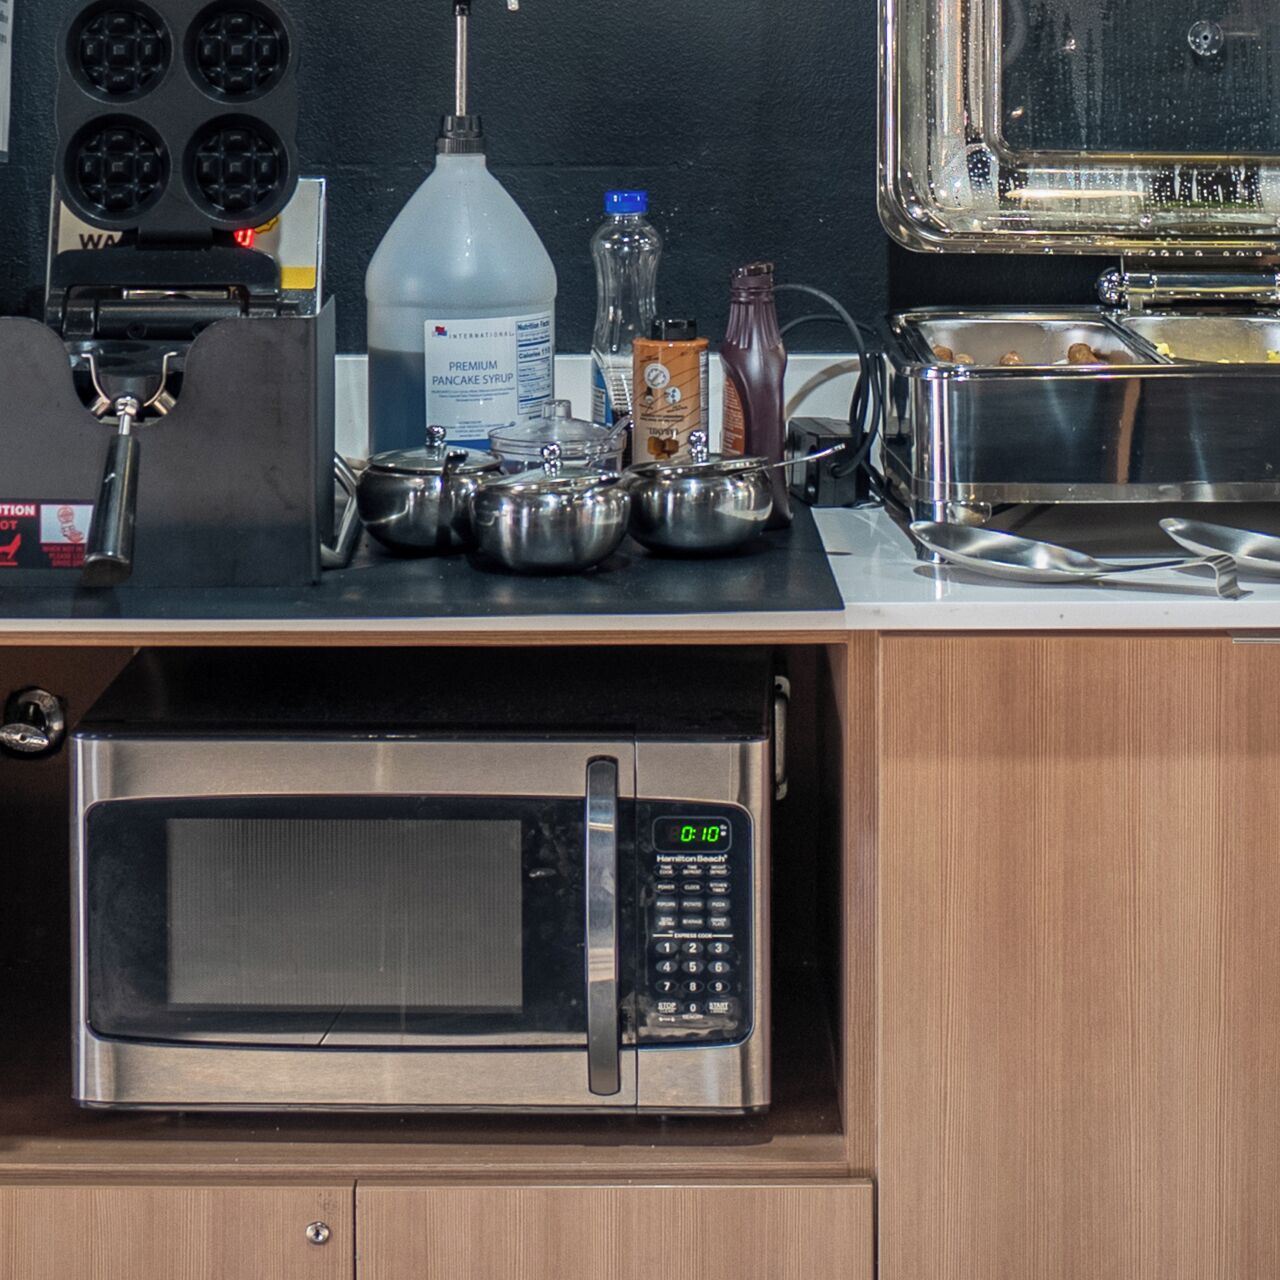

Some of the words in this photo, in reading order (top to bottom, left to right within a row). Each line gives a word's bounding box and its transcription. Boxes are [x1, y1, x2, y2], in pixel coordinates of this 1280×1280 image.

[449, 360, 497, 372] PREMIUM
[432, 375, 480, 386] PANCAKE
[482, 373, 514, 384] SYRUP
[680, 825, 720, 842] 0:10
[656, 854, 697, 863] Hamilton
[697, 854, 725, 863] Beach
[663, 942, 670, 953] 1
[688, 942, 697, 953] 2
[714, 942, 723, 953] 3
[662, 961, 671, 972] 4
[688, 961, 697, 972] 5
[714, 962, 723, 973] 6
[663, 981, 671, 991] 7
[689, 981, 697, 991] 8
[714, 981, 723, 991] 9
[657, 1002, 677, 1010] STOP
[689, 1003, 697, 1012] 0
[708, 1001, 729, 1010] START
